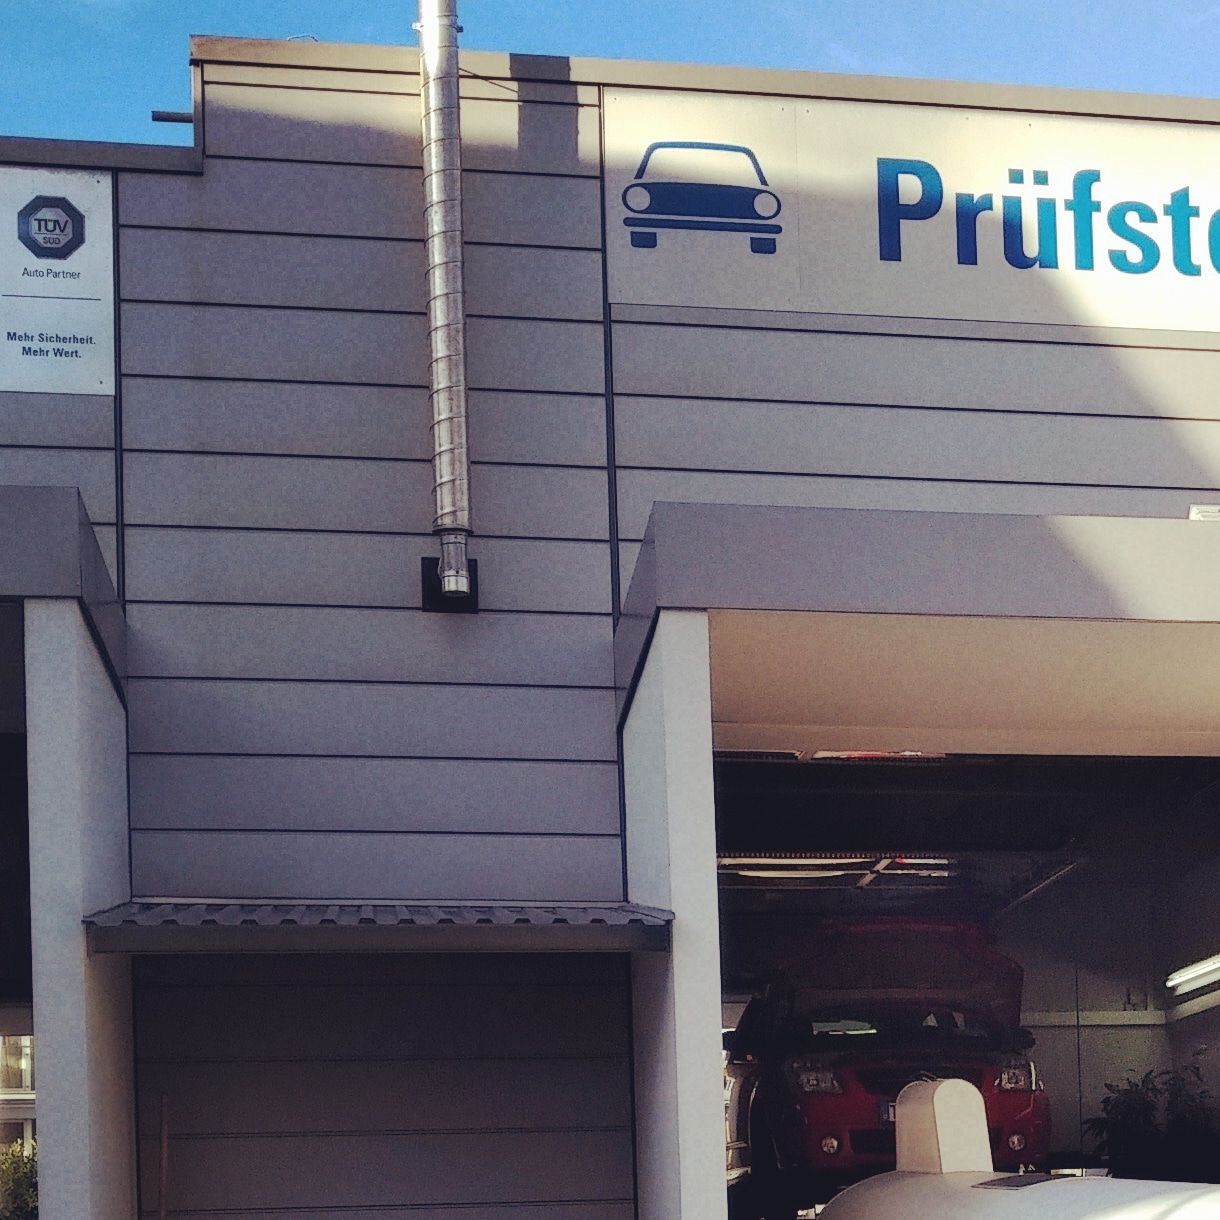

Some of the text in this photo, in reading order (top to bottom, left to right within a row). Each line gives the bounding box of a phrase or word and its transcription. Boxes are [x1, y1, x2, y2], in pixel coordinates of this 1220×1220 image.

[33, 218, 69, 233] TÜV
[21, 267, 81, 279] Auto Partner
[6, 331, 96, 345] Mehr Sicherheit.
[21, 346, 82, 359] Mehr Wert.
